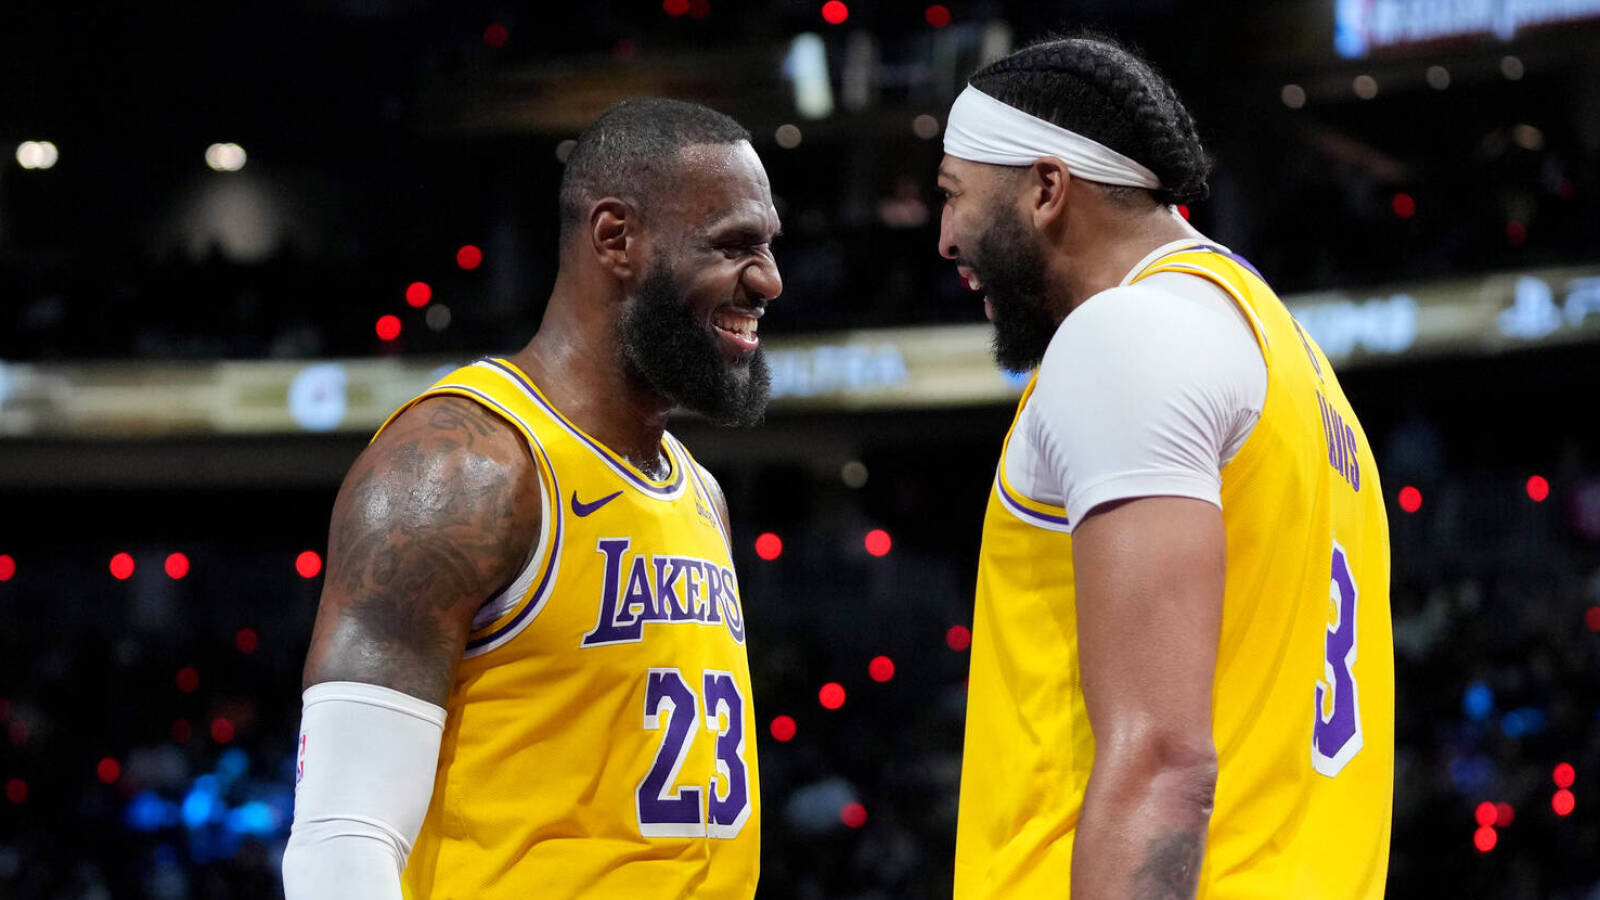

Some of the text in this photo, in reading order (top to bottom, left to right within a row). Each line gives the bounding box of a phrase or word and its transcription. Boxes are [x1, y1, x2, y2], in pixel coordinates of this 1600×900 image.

[1316, 389, 1360, 492] AVIS
[580, 537, 745, 649] LAKERS
[1311, 539, 1363, 778] 3
[635, 668, 752, 839] 23
